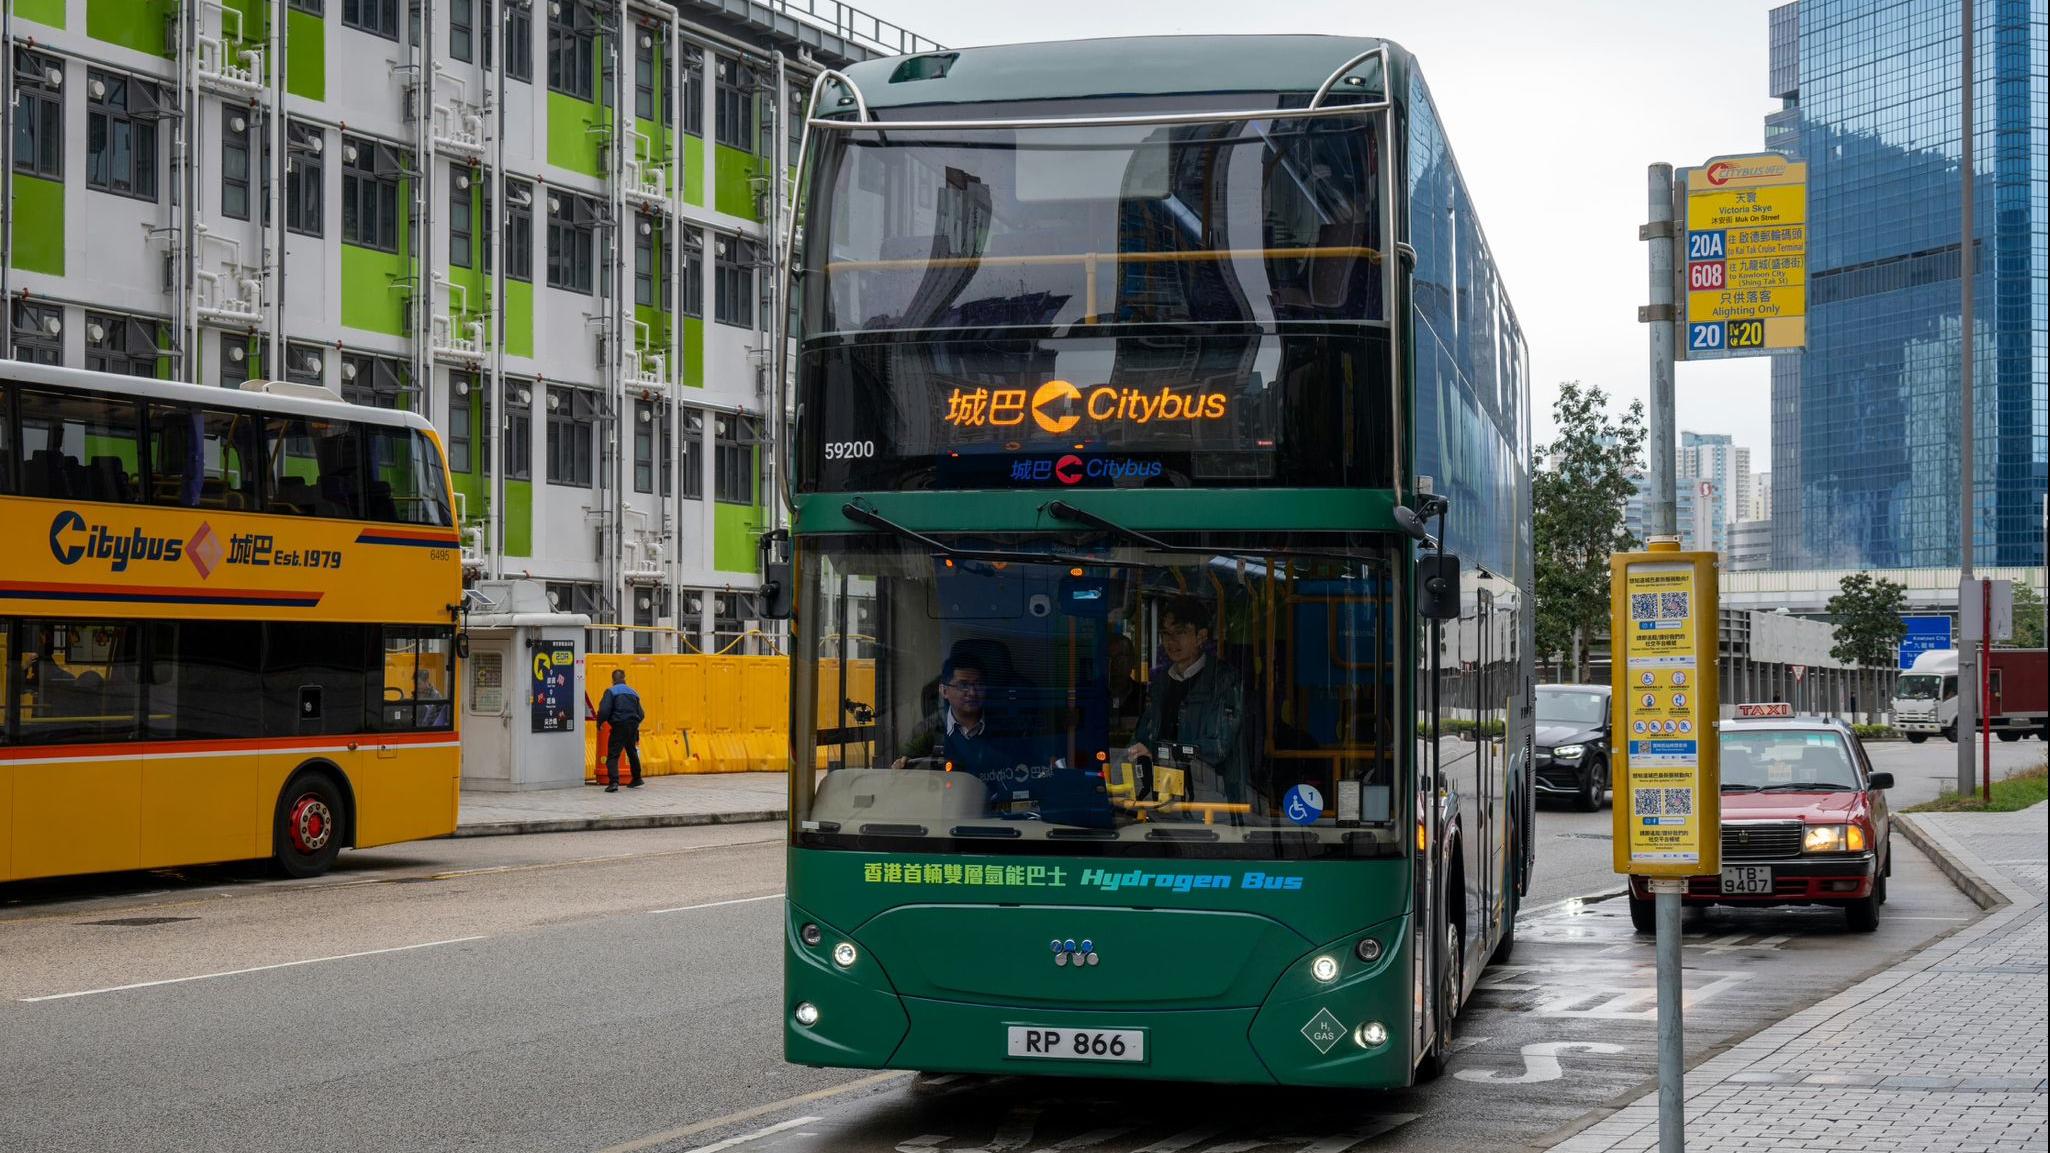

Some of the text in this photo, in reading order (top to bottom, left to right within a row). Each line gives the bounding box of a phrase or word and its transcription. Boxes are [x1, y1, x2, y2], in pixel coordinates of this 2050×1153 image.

[1719, 204, 1772, 215] Victoria Skye
[1735, 215, 1749, 223] Muk
[1760, 213, 1780, 222] Street
[1691, 233, 1723, 258] 20A
[1692, 264, 1722, 287] 608
[1738, 271, 1769, 280] Kowloon
[1771, 270, 1785, 280] City
[1739, 278, 1761, 288] (Shing
[1763, 278, 1776, 286] Tak
[1720, 290, 1771, 304] 只供落客
[1712, 304, 1780, 319] Alighting Only
[1694, 325, 1720, 348] 20
[944, 386, 1226, 427] 城巴 Citybus
[824, 440, 874, 460] 59200
[1010, 458, 1162, 480] 城巴 Citybus
[50, 510, 184, 572] Citybus
[226, 533, 273, 566] 城巴
[430, 549, 449, 562] 6495
[1739, 703, 1789, 716] TAXI
[1735, 867, 1757, 879] TB
[1080, 869, 1230, 892] Hydrogen
[1241, 872, 1304, 890] Bus
[1724, 879, 1768, 893] 9407
[1313, 1031, 1335, 1041] GAS
[1026, 1030, 1126, 1057] RP 866
